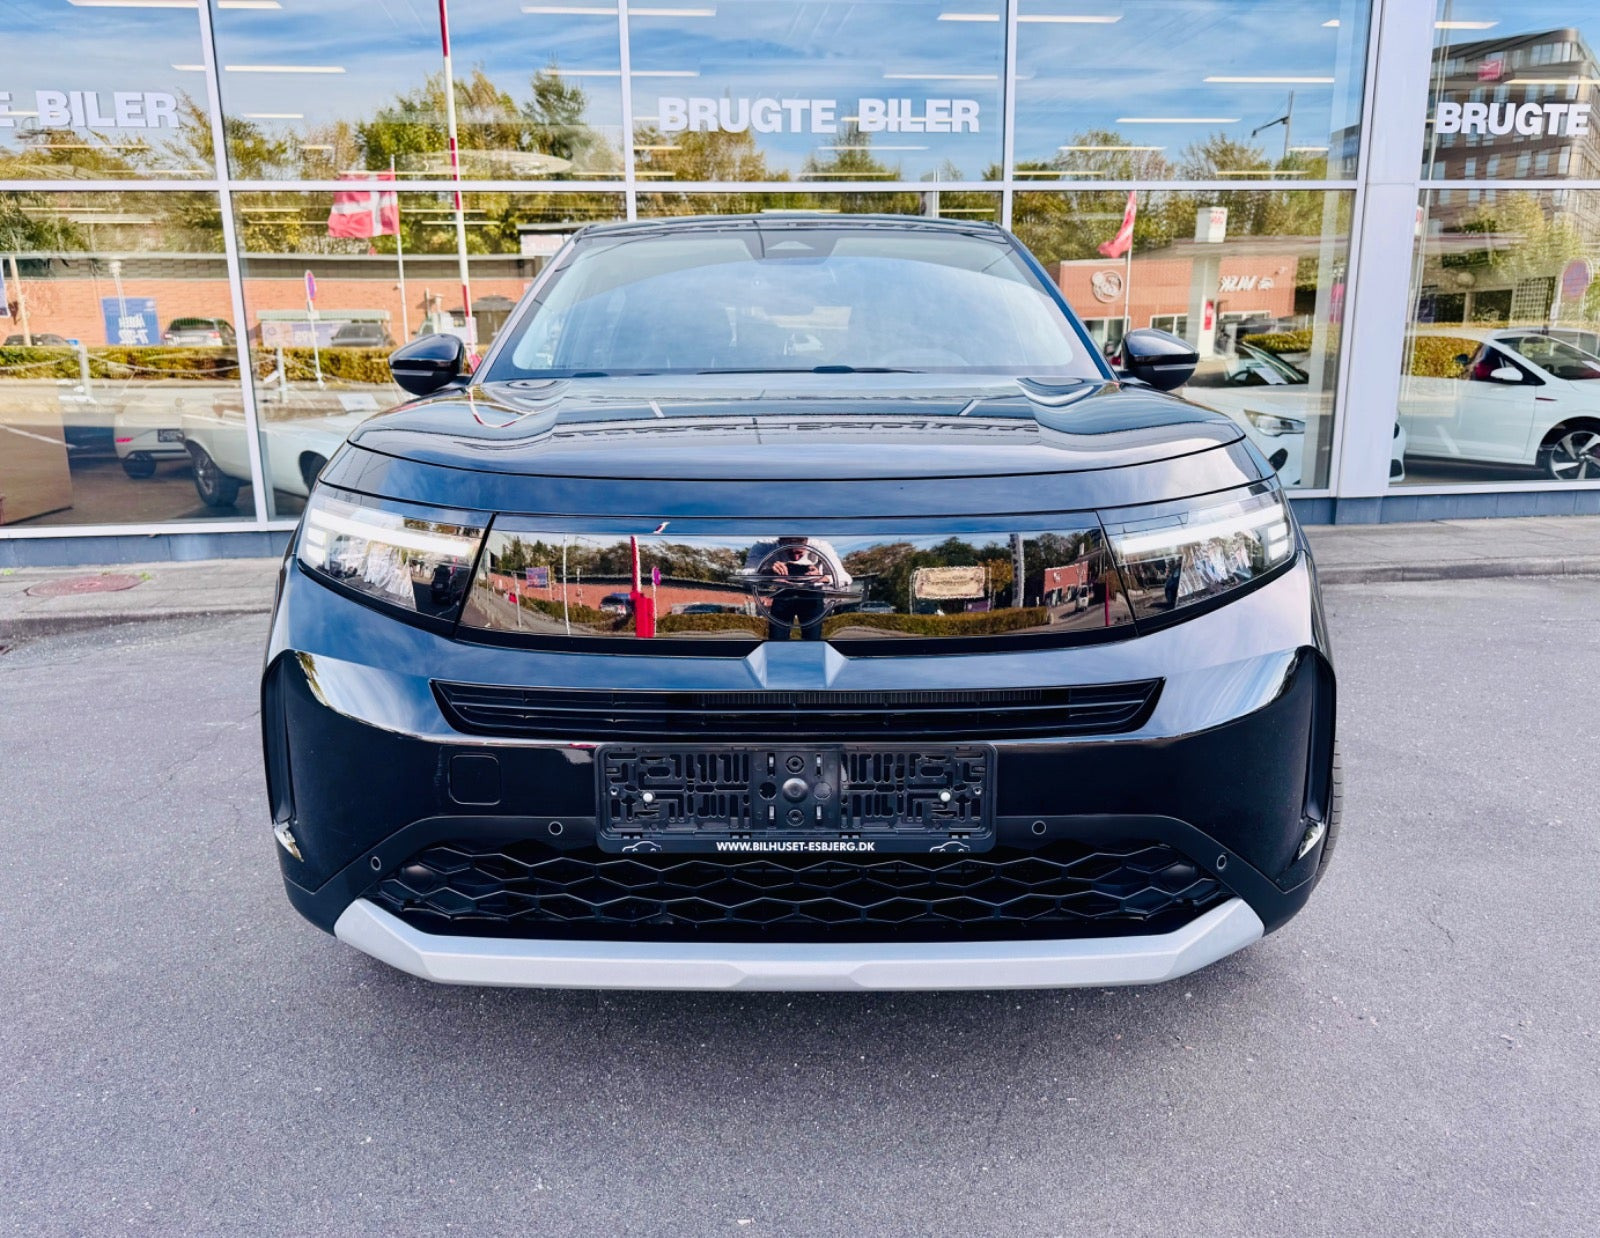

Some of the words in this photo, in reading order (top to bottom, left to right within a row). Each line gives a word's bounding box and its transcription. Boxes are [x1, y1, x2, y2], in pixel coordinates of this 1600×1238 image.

[35, 90, 182, 128] BILER
[658, 97, 837, 134] BRUGTE
[857, 98, 981, 134] BILER
[1435, 102, 1592, 136] BRUGTE
[716, 841, 875, 852] WWW.BILHUSET-ESBJERG.DK
